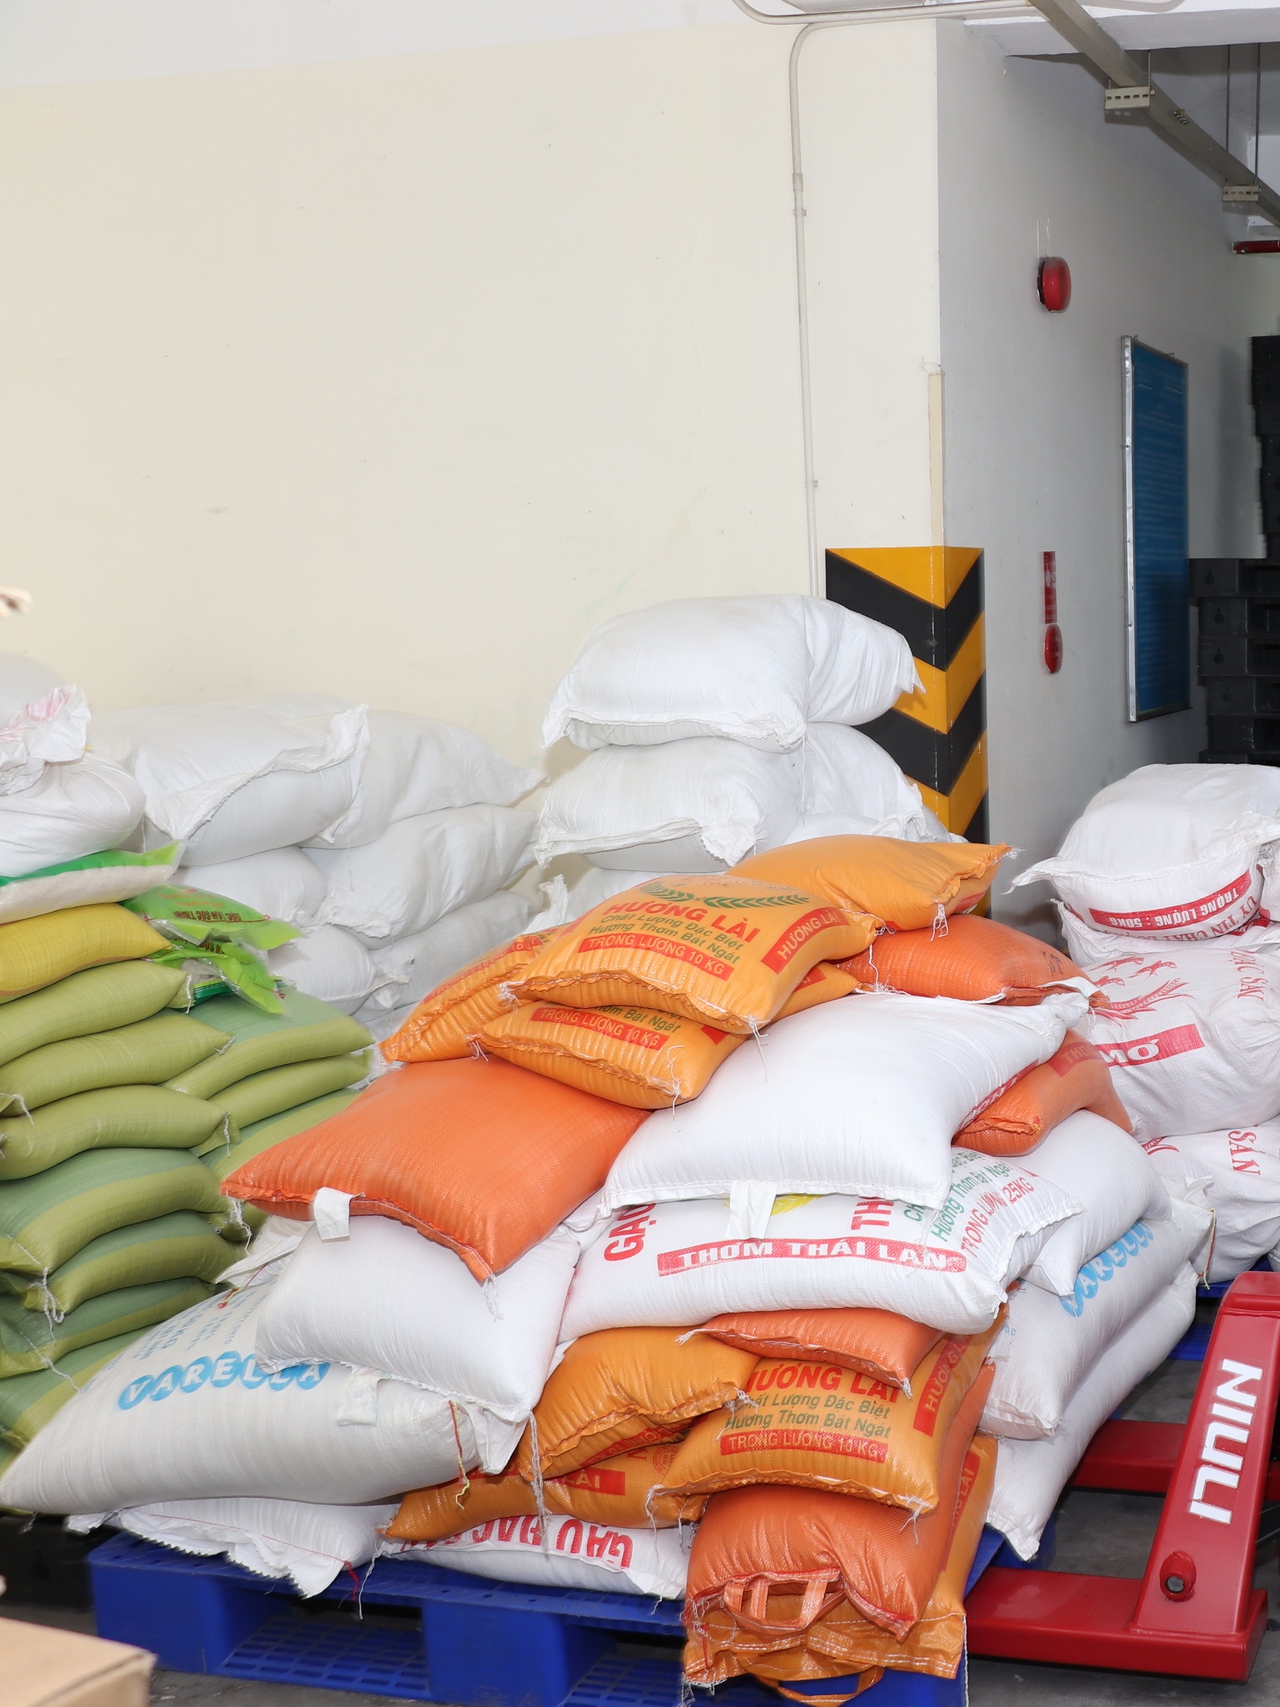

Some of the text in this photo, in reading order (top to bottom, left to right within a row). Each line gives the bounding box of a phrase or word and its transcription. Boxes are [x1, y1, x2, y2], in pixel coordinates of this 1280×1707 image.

[1202, 887, 1239, 912] TRỌNG
[602, 900, 761, 943] HƯƠNG LÀI
[1109, 916, 1142, 928] 50KG
[1155, 907, 1198, 927] LƯỢNG
[639, 922, 679, 937] Thơm
[777, 917, 821, 960] HƯƠNG
[714, 933, 744, 951] Biệt
[689, 951, 704, 964] 10
[704, 958, 725, 975] KG
[627, 1027, 640, 1040] 10
[641, 1032, 661, 1048] KG
[1002, 1177, 1034, 1204] 25KG
[679, 1238, 947, 1269] THƠM THÁI LAN
[736, 1394, 770, 1411] hất
[858, 1400, 891, 1420] Biệt
[779, 1410, 819, 1425] Thơm
[838, 1437, 853, 1453] 10
[857, 1441, 878, 1458] KG
[1189, 1358, 1263, 1525] NIULI
